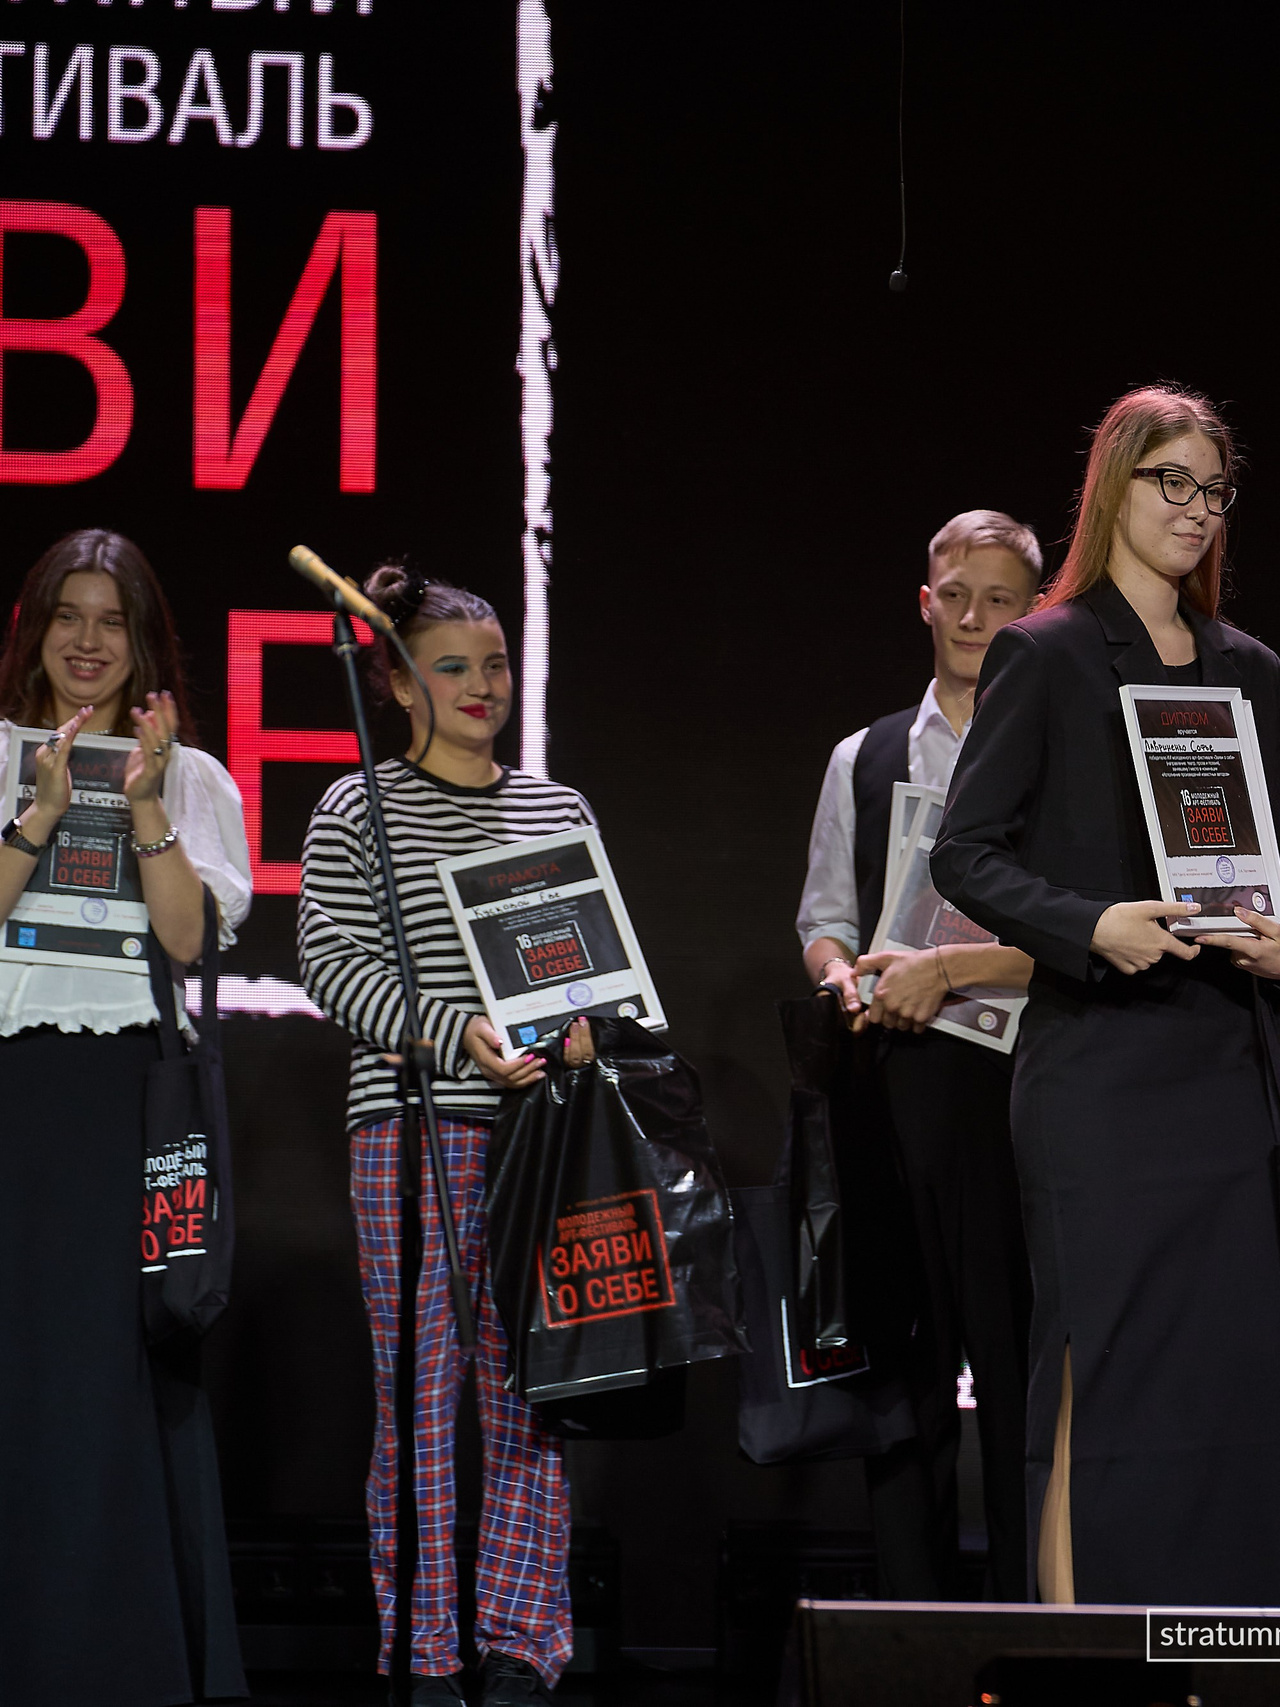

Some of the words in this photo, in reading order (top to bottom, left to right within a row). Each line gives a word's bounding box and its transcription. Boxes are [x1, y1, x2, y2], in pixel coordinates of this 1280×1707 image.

[0, 199, 377, 494] ВИ
[1160, 711, 1209, 726] ДИПЛОМ
[1180, 789, 1192, 806] 16
[1186, 807, 1225, 823] ЗАЯВИ
[56, 831, 71, 848] 16
[1191, 827, 1200, 843] О
[1202, 826, 1229, 843] СЕБЕ
[59, 848, 113, 868] ЗАЯВИ
[57, 866, 69, 883] О
[72, 868, 111, 888] СЕБЕ
[488, 862, 561, 889] ГРАМОТА
[515, 933, 533, 950] 16
[525, 938, 578, 963] ЗАЯВИ
[530, 963, 543, 979] О
[544, 955, 584, 976] СЕБЕ
[551, 1230, 653, 1278] ЗАЯВИ
[557, 1284, 578, 1315] О
[585, 1268, 660, 1309] СЕБЕ
